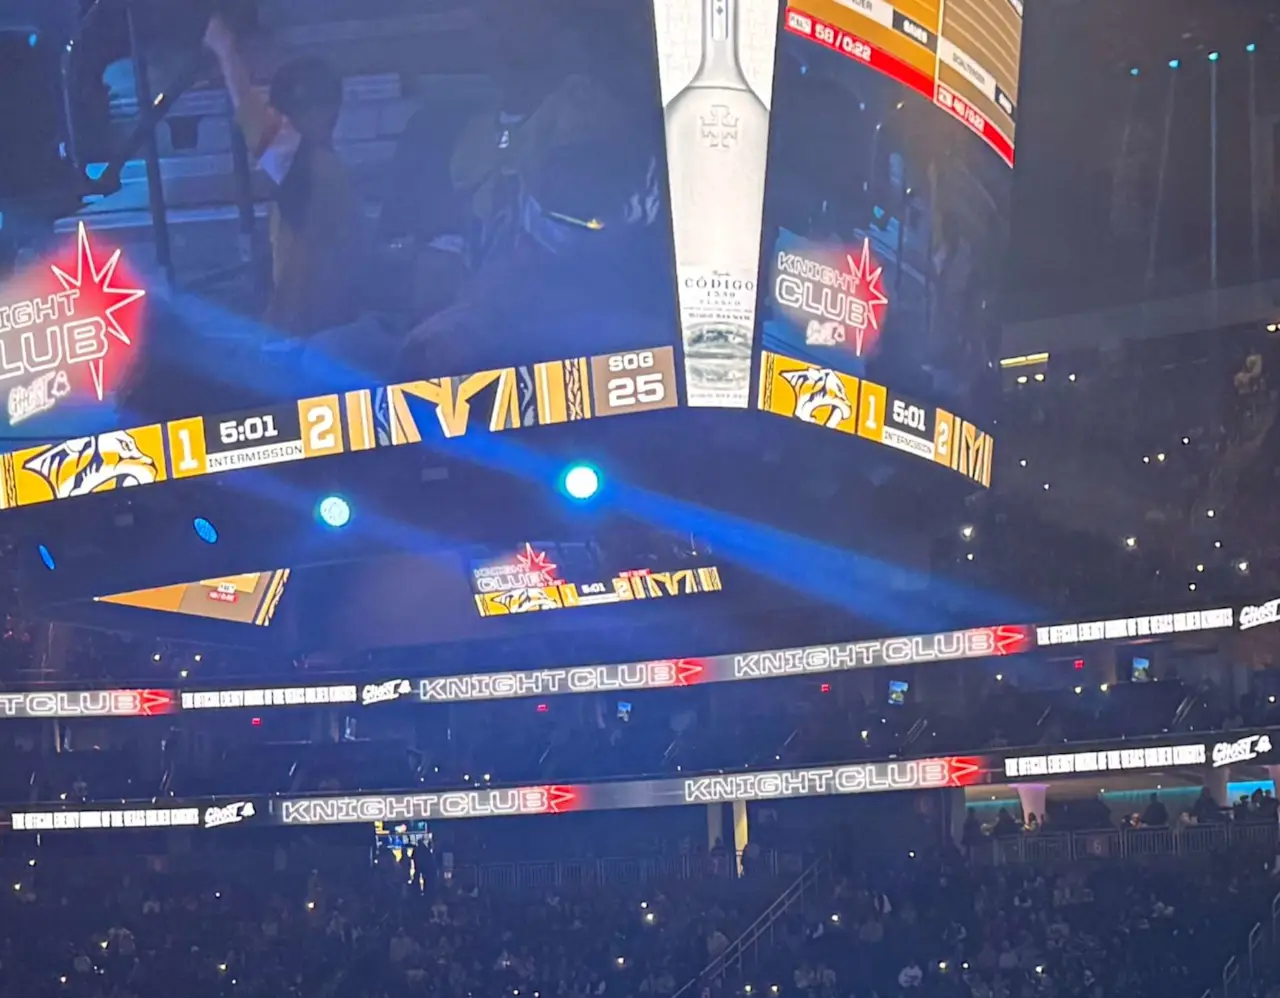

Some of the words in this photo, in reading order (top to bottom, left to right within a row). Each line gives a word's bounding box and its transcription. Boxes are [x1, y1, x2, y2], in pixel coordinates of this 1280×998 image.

[685, 276, 754, 291] CÓDIGO
[778, 251, 860, 294] KNIGHT
[776, 274, 870, 329] CLUB
[608, 351, 654, 373] SOG
[608, 374, 664, 408] 25
[220, 414, 279, 444] 5:01
[307, 405, 336, 449] 2
[865, 395, 877, 430] 1
[892, 400, 926, 432] 5:01
[178, 428, 198, 472] 1
[938, 421, 949, 457] 2
[208, 445, 303, 468] INTERMISSION
